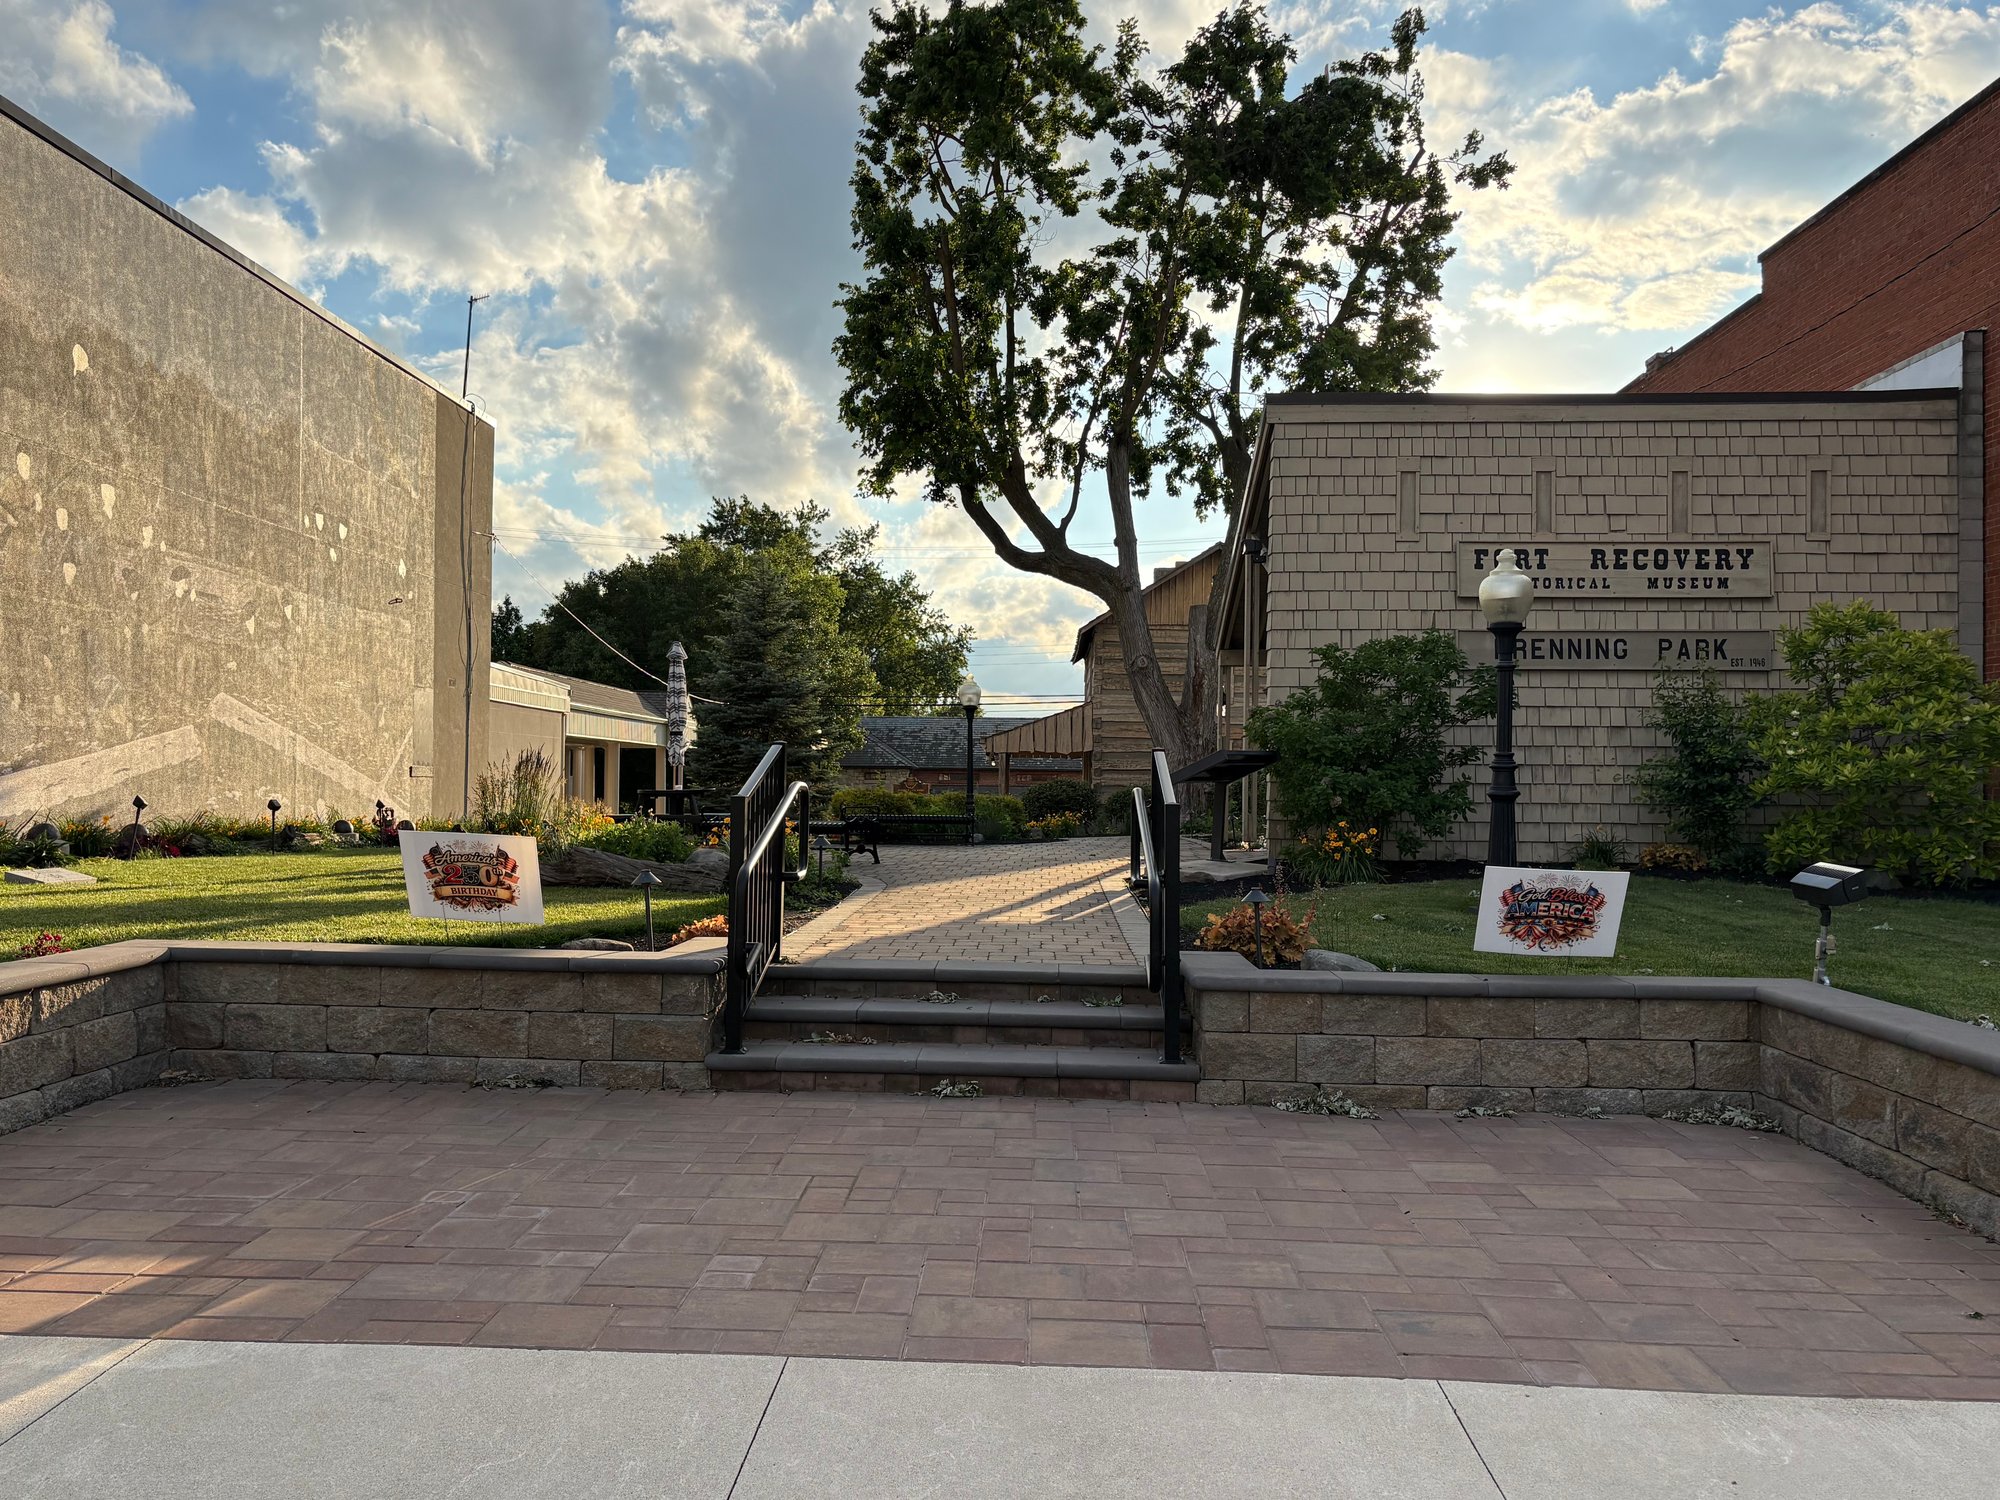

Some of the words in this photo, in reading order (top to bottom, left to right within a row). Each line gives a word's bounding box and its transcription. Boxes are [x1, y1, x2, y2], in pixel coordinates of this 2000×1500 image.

[1590, 549, 1754, 570] RECOVERY
[1531, 577, 1611, 589] TORICAL
[1647, 577, 1729, 589] MUSEUM
[1495, 638, 1628, 660] RENNING
[1658, 638, 1728, 660] PARK
[1749, 657, 1766, 667] 1946
[434, 849, 499, 866] America's
[450, 886, 498, 897] BIRTHDAY
[1517, 887, 1551, 903] God
[1549, 887, 1590, 904] Bless
[1506, 901, 1595, 921] AMERICA
